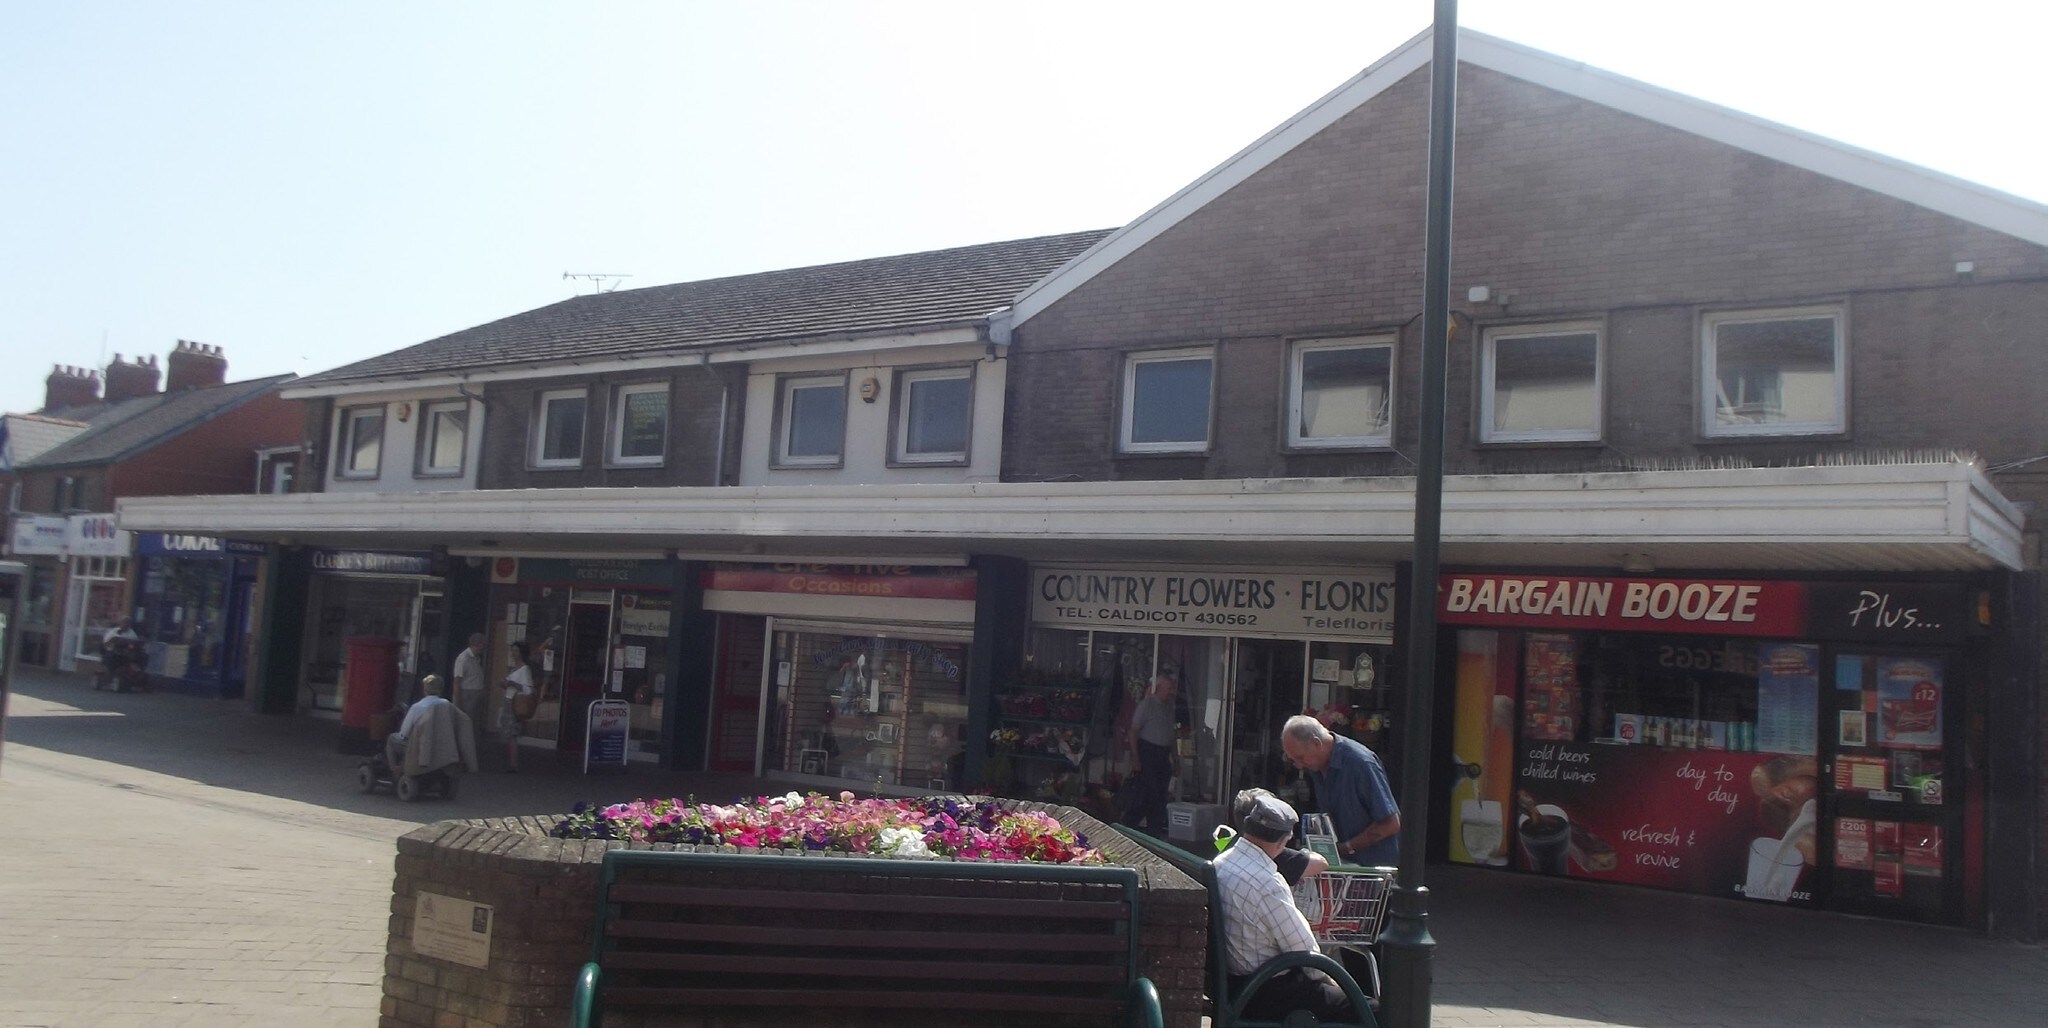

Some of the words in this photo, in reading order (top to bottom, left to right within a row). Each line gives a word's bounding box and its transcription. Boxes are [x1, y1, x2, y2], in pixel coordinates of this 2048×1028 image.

[577, 568, 599, 579] POST
[600, 569, 629, 580] OFFICE
[788, 576, 893, 594] Occasions
[1041, 574, 1156, 605] COUNTRY
[1165, 577, 1275, 610] FLOWERS
[1447, 579, 1613, 616] BARGAIN
[1620, 582, 1762, 622] BOOZE
[1849, 590, 1942, 629] Plus...
[1056, 606, 1092, 619] TEL:
[1098, 608, 1190, 622] CALDICOT
[1195, 612, 1258, 626] 430562
[1529, 744, 1555, 760] cold
[1558, 745, 1591, 764] beers
[1522, 762, 1560, 780] chilled
[1562, 767, 1597, 783] wines
[1676, 761, 1707, 791] day
[1713, 763, 1735, 781] to
[1707, 785, 1739, 815] day
[1622, 823, 1680, 846] refresh
[1687, 829, 1697, 847] &
[1840, 822, 1868, 832] £200
[1635, 850, 1681, 869] revive
